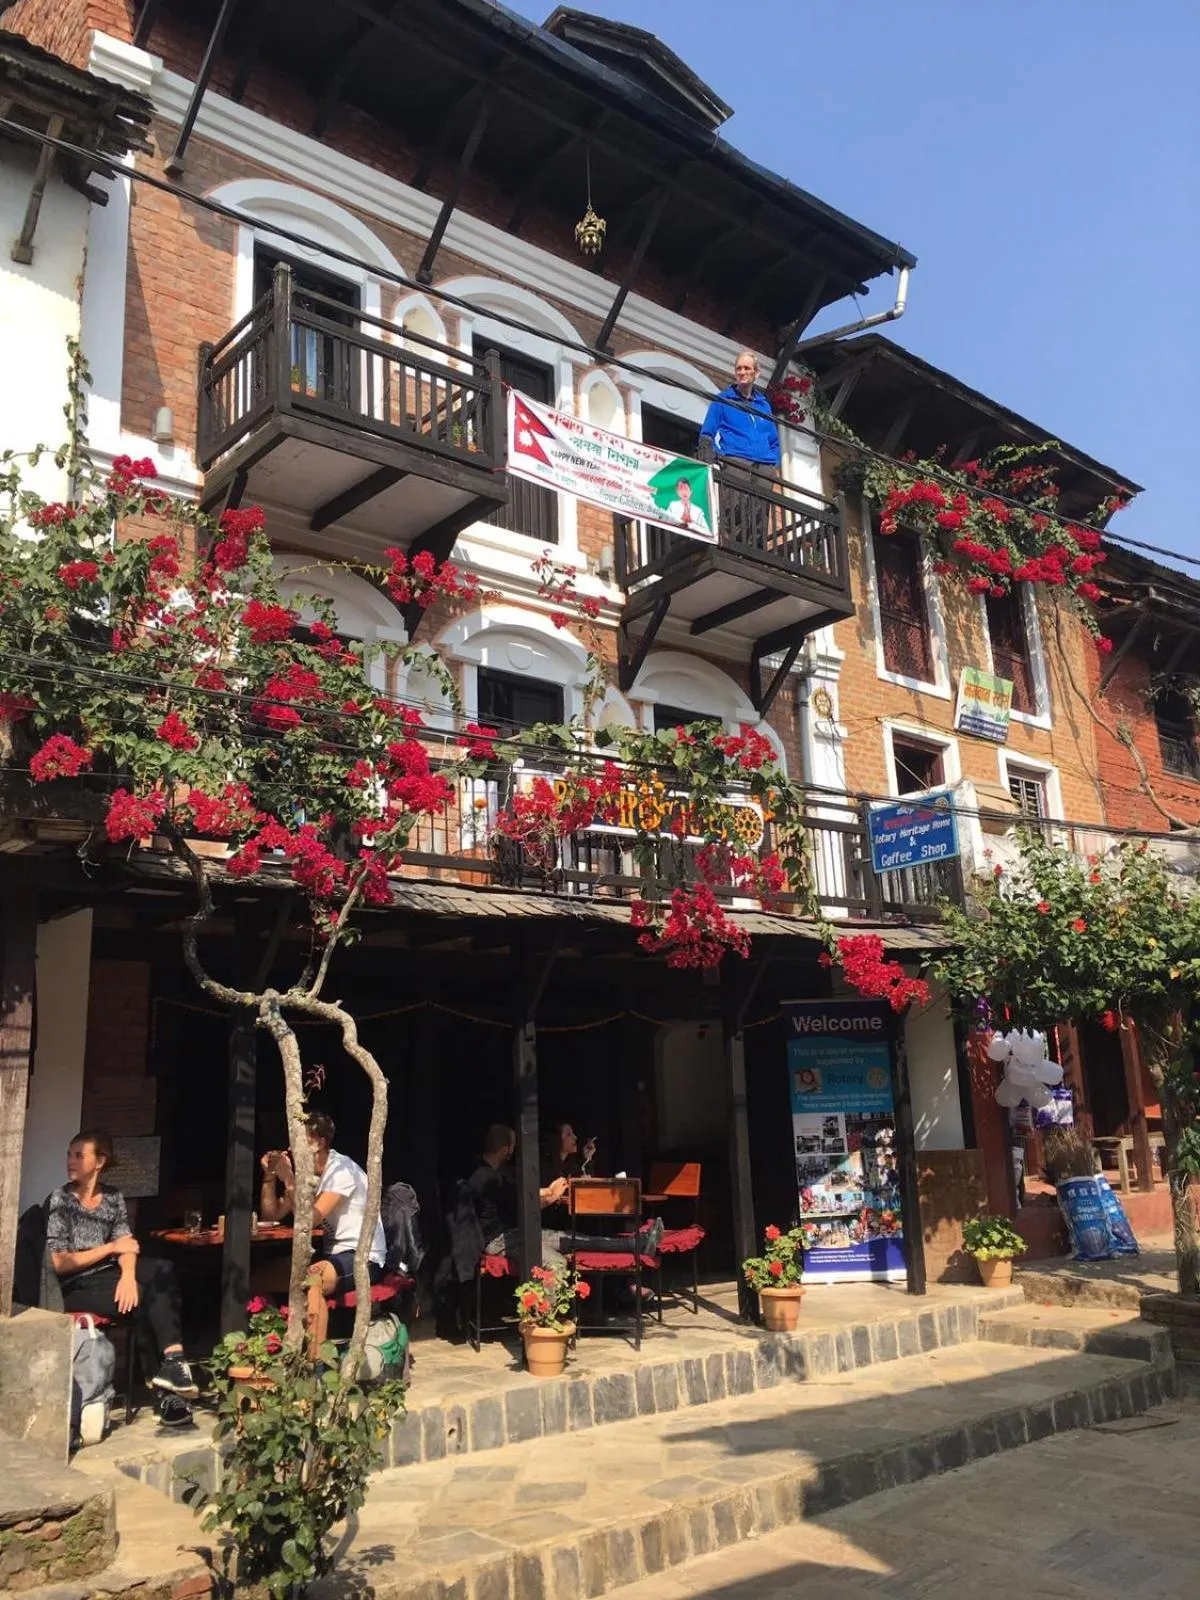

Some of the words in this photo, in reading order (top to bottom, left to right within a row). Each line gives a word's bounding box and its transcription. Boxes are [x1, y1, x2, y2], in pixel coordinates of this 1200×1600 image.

[881, 851, 912, 867] Coffee
[921, 843, 947, 858] Shop
[792, 1015, 882, 1032] Welcome
